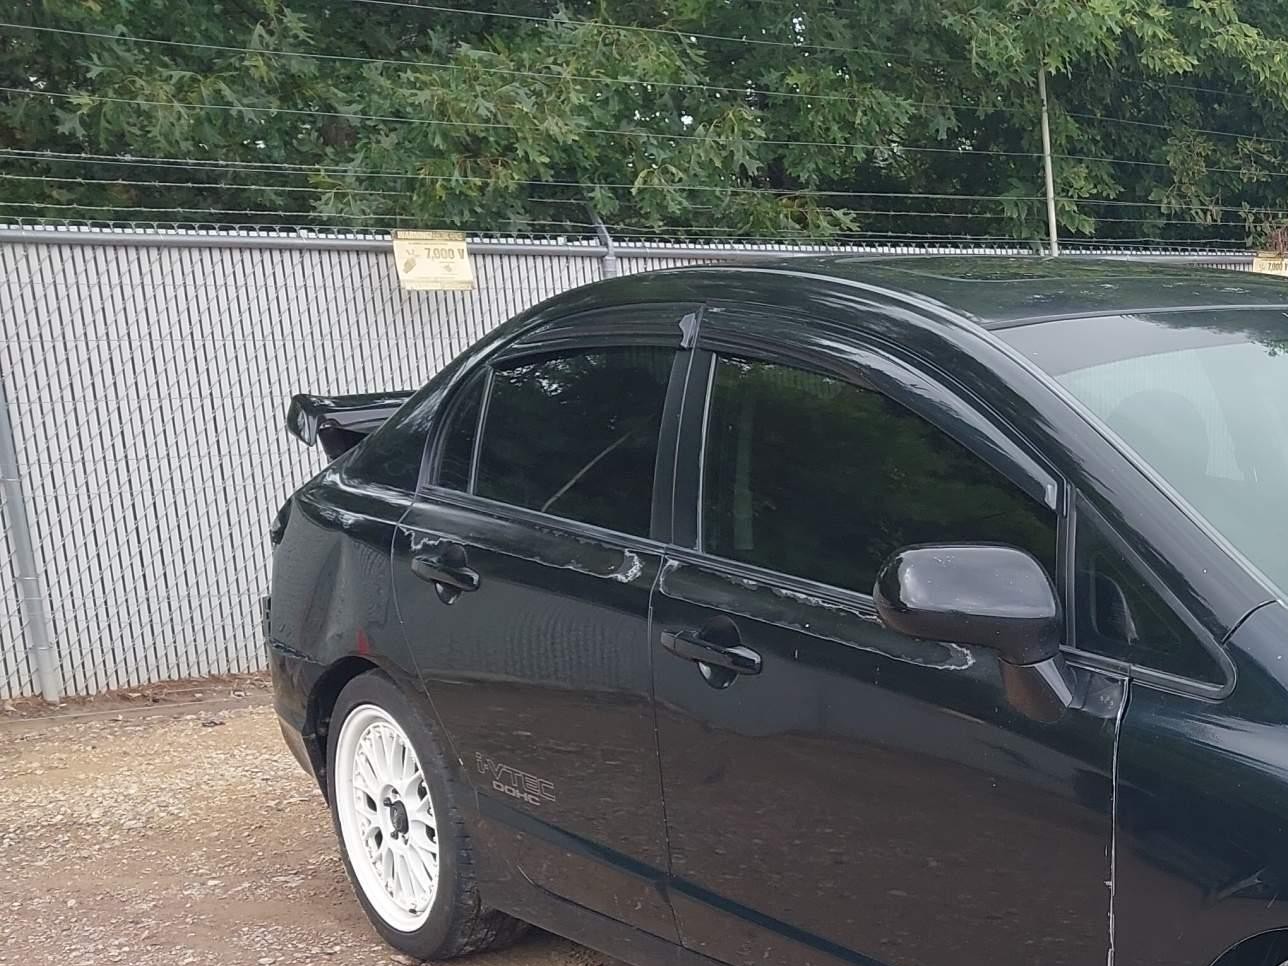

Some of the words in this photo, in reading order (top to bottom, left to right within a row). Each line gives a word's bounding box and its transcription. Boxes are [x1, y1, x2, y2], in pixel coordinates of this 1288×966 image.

[424, 248, 455, 261] 7,000
[457, 248, 465, 260] V
[492, 780, 541, 806] DOHC
